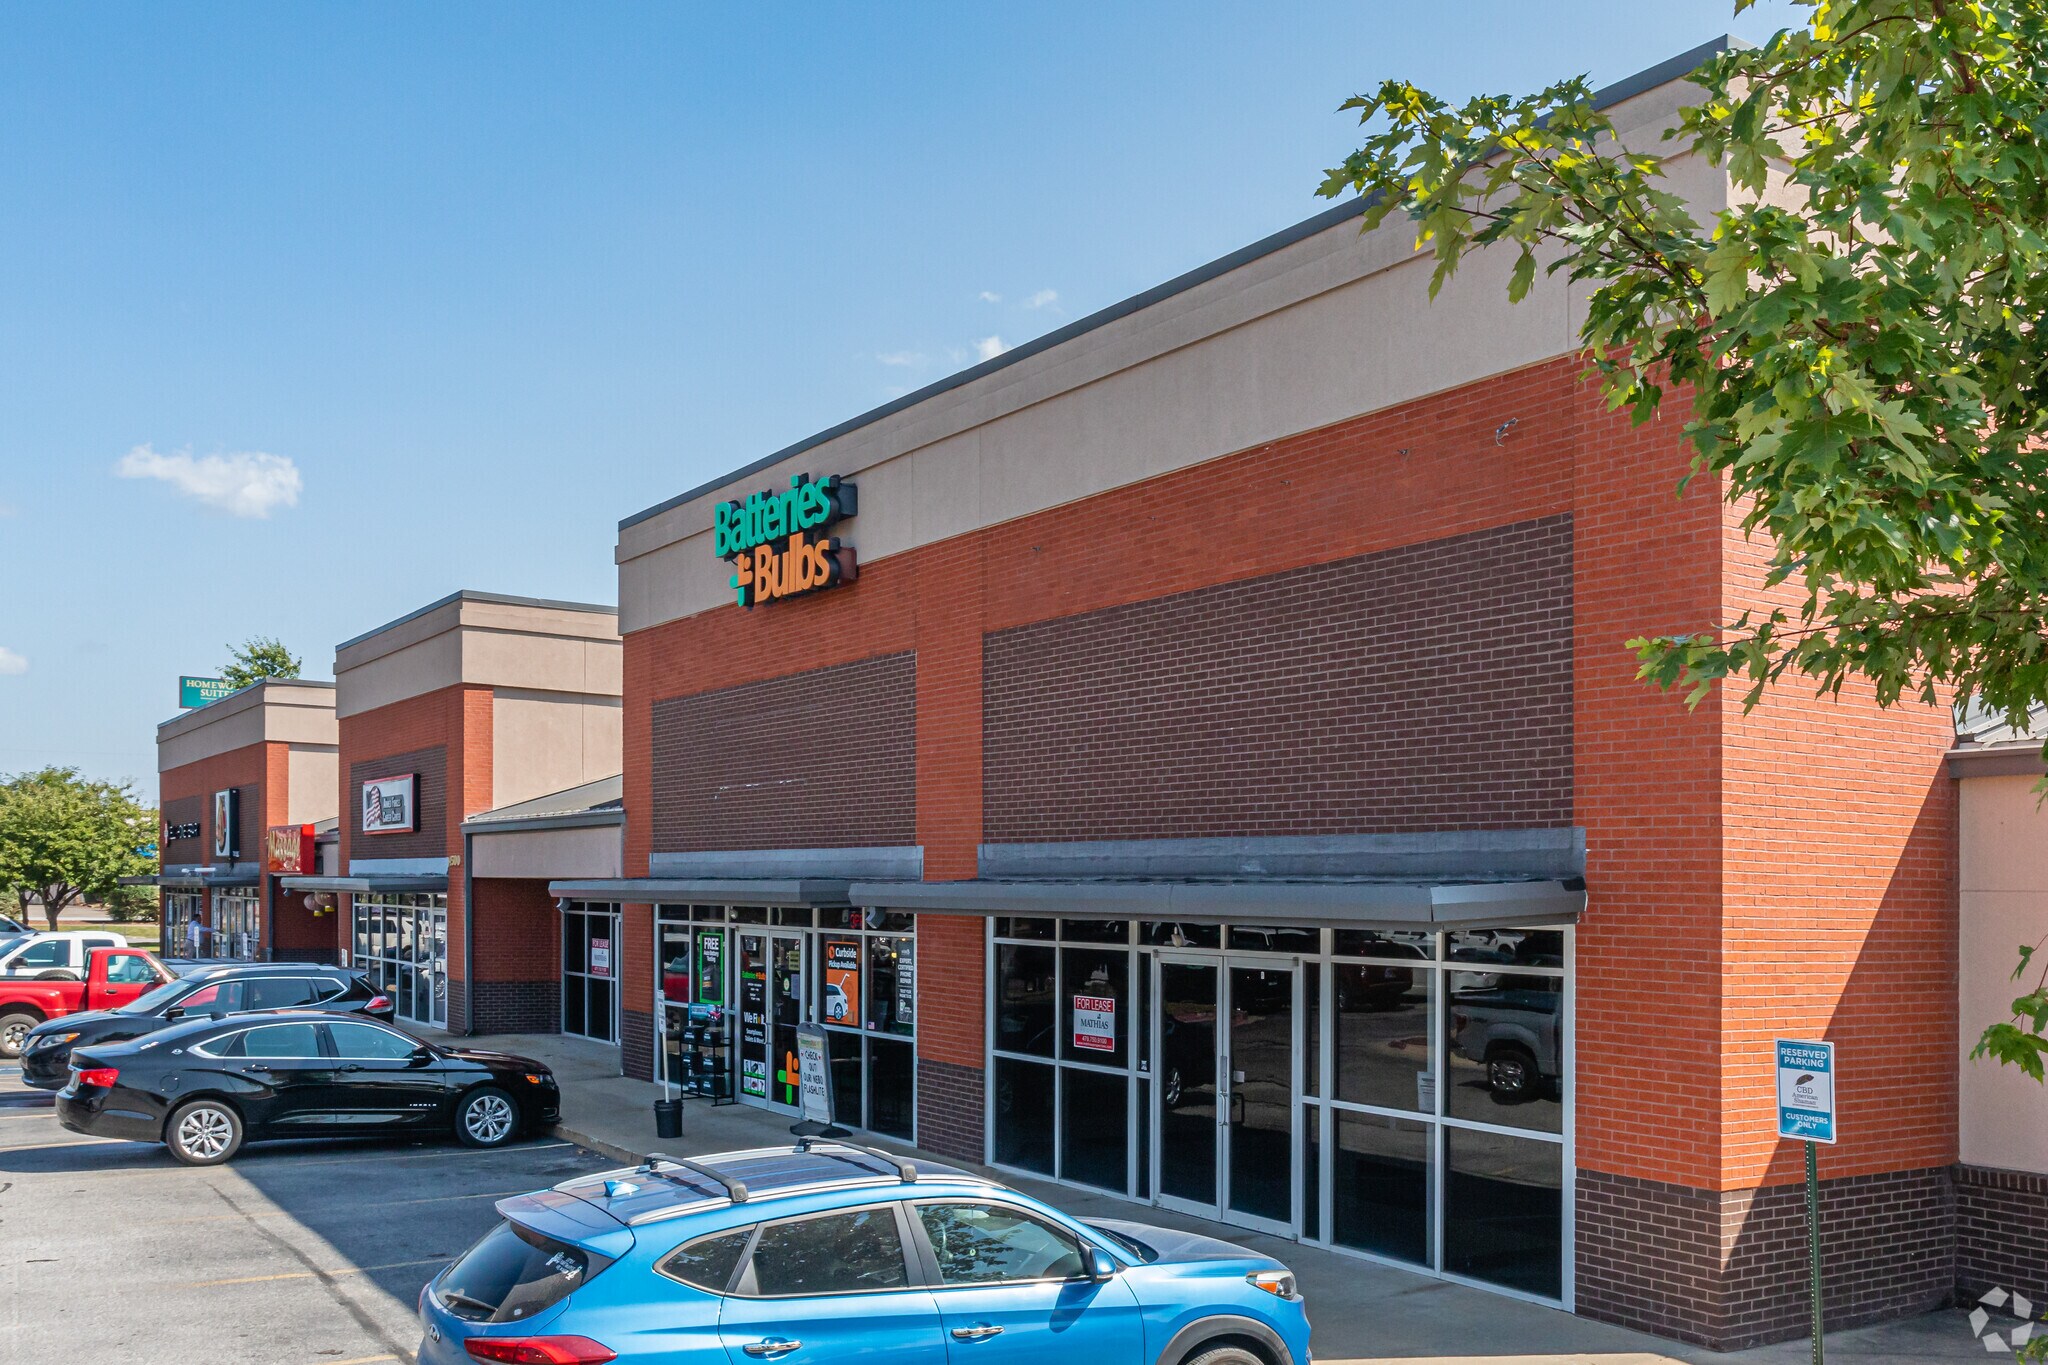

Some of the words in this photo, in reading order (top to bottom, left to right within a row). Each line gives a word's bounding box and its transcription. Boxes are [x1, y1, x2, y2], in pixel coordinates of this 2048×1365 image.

[715, 475, 831, 558] Batteries
[755, 532, 830, 602] Bulbs
[704, 937, 719, 950] FREE
[836, 948, 857, 958] Curbside
[1077, 998, 1090, 1009] FOR
[1091, 1000, 1112, 1011] LEASE
[1080, 1019, 1109, 1029] MATHIAS
[804, 1050, 818, 1061] CHECK
[1781, 1048, 1827, 1060] RESERVED
[809, 1062, 817, 1072] OUT
[1784, 1056, 1824, 1068] PARKING
[803, 1072, 812, 1083] OUR
[803, 1083, 825, 1096] FLASHLITE
[1797, 1086, 1813, 1095] CBD
[1792, 1092, 1818, 1100] American
[1786, 1112, 1828, 1125] CUSTOMERS
[1797, 1121, 1817, 1130] ONLY
